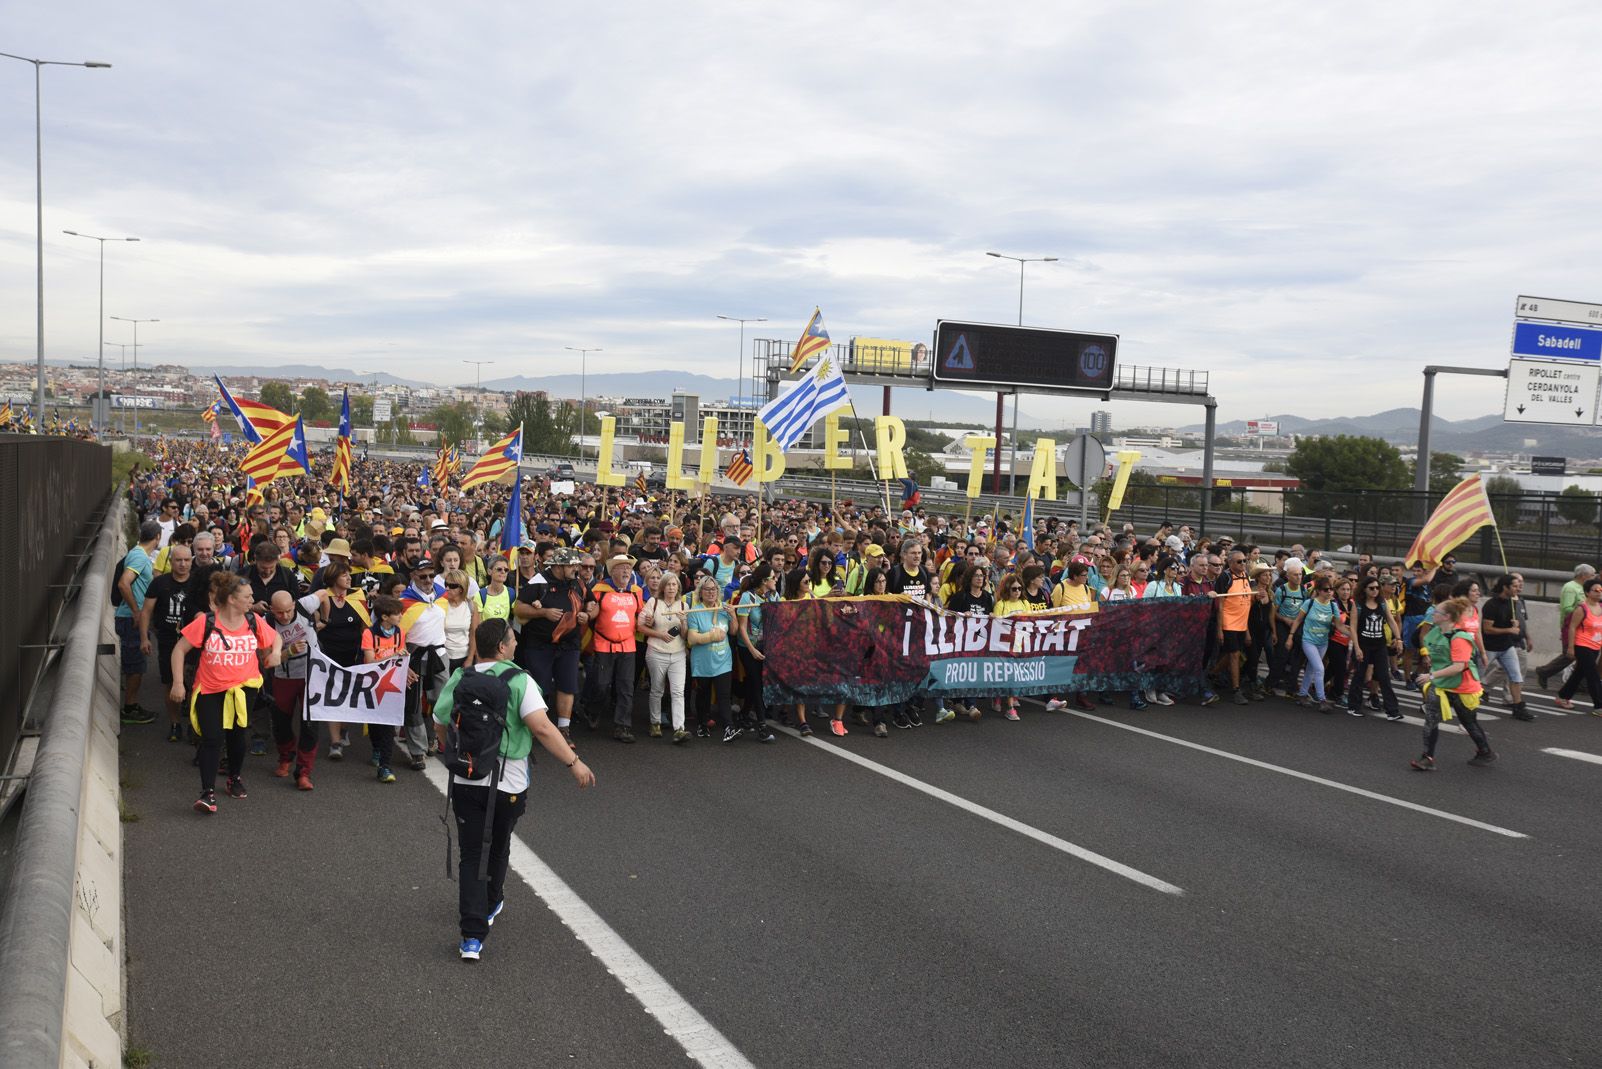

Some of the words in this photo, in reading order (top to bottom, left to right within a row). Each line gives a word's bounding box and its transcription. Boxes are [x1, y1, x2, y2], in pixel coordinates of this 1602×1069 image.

[1537, 334, 1582, 350] Sabadell
[1083, 352, 1105, 371] 100
[1529, 368, 1563, 379] RIPOLLET
[1527, 382, 1579, 394] CERDANYOLA
[1531, 394, 1543, 402] DEL
[924, 608, 1092, 656] LLIBERTAT
[207, 636, 256, 651] MORE
[945, 661, 977, 684] PROU
[983, 656, 1046, 682] REPRESSIÓ
[308, 658, 379, 709] CDR
